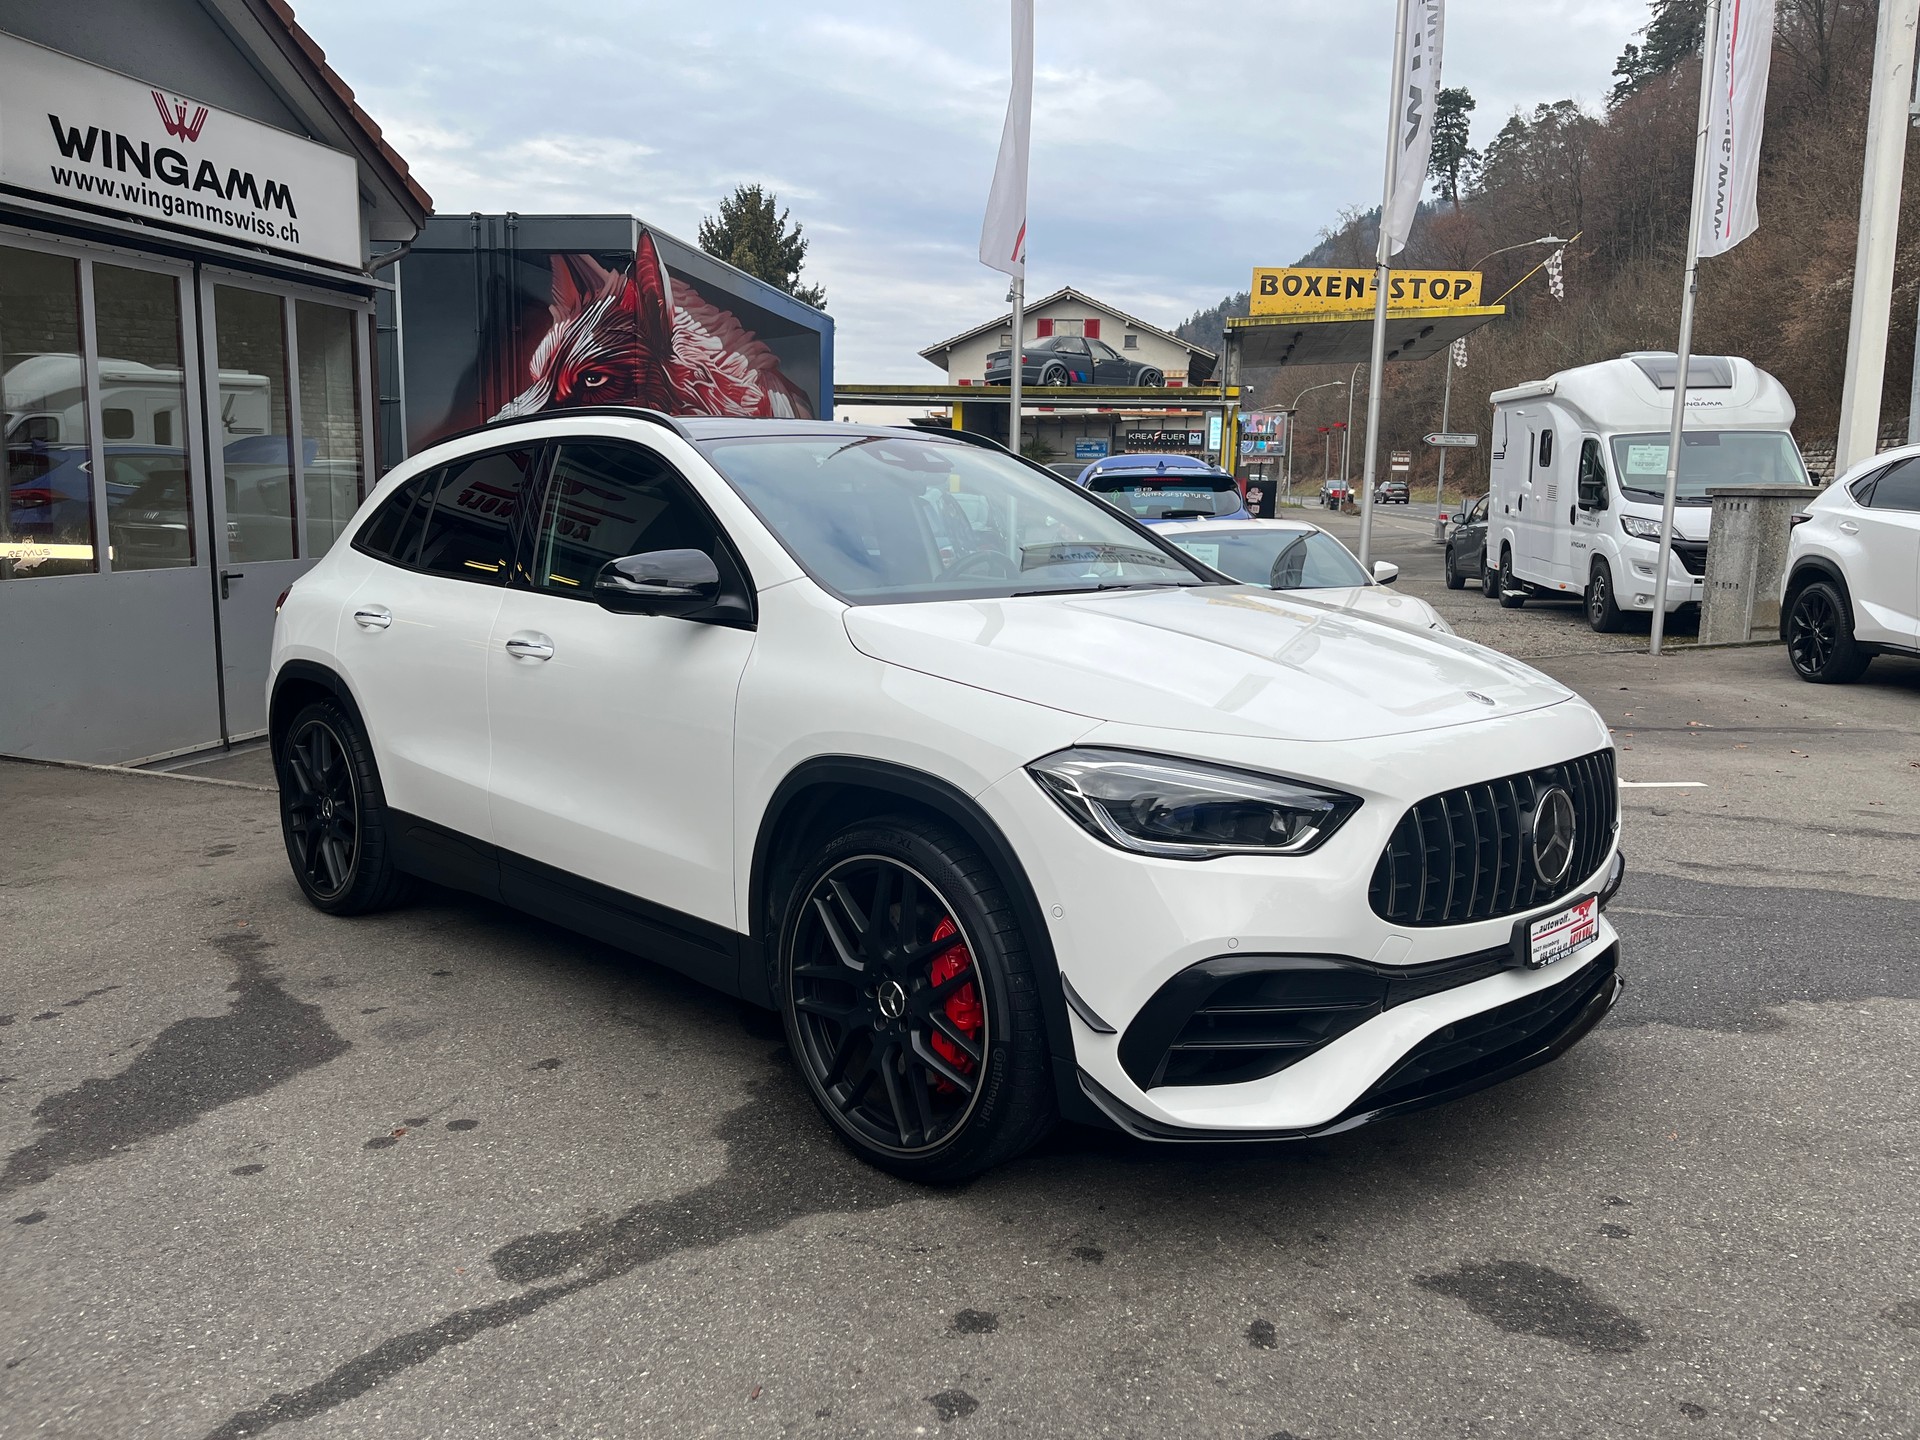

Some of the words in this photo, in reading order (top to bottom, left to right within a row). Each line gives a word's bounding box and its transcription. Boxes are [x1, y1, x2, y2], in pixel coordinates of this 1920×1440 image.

[47, 113, 297, 219] WINGAMM
[51, 164, 300, 243] www.wingammswiss.ch
[1243, 433, 1276, 441] Diesel
[7, 548, 51, 558] REMUS
[1548, 953, 1560, 964] AUTO
[1560, 947, 1572, 958] WOLF
